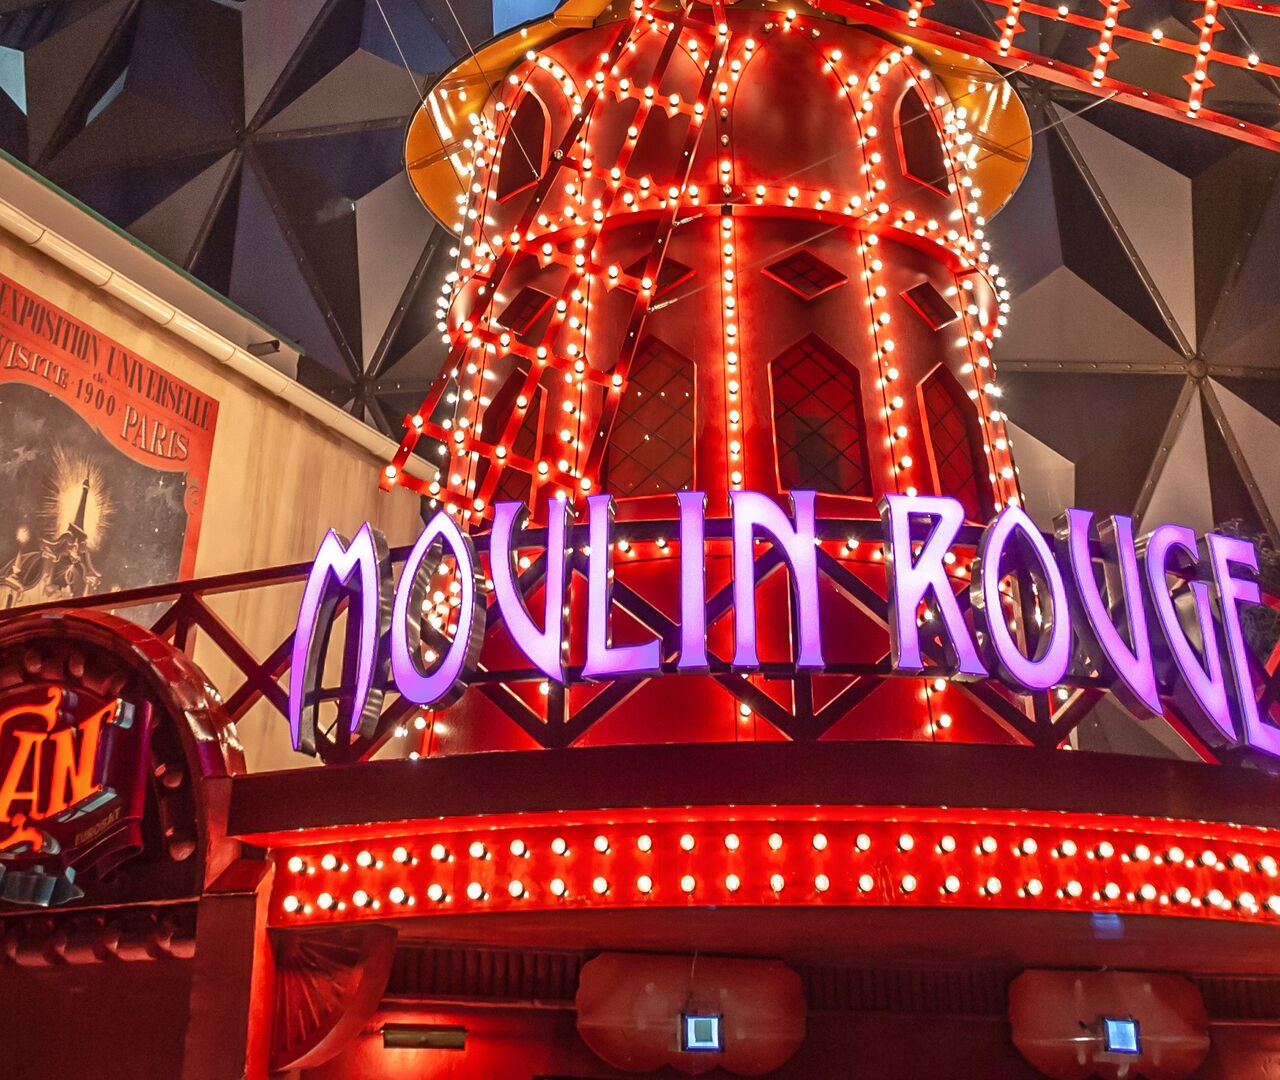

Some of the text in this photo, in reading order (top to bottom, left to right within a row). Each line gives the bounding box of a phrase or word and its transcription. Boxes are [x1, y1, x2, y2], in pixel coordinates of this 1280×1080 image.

[76, 378, 116, 417] 1900
[120, 403, 191, 461] PARIS
[106, 346, 213, 431] UNIVERSELLE
[289, 489, 826, 753] MOULIN
